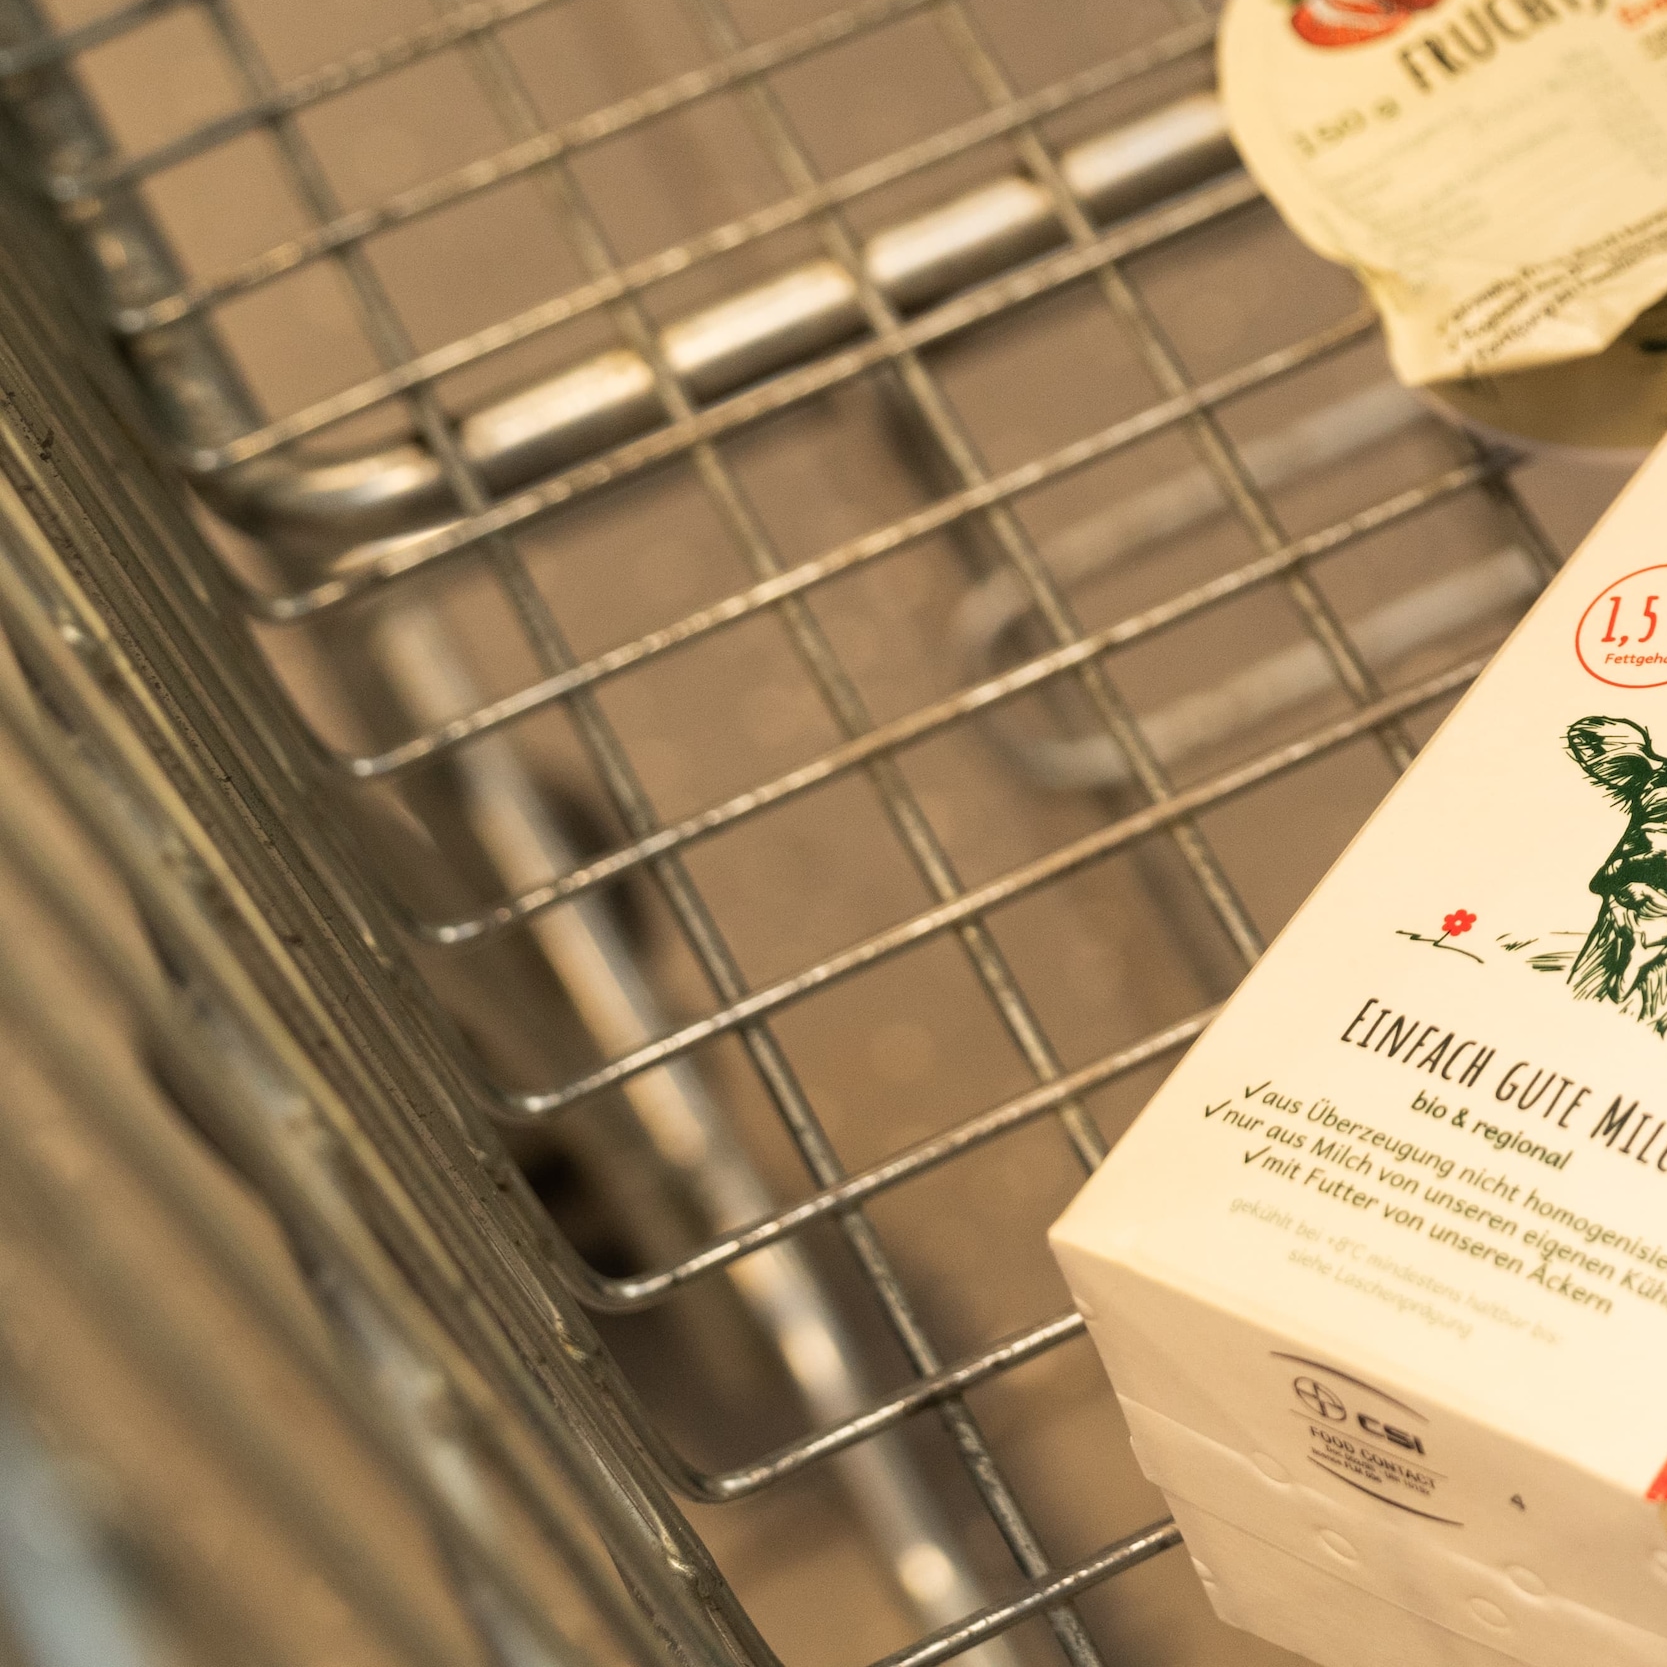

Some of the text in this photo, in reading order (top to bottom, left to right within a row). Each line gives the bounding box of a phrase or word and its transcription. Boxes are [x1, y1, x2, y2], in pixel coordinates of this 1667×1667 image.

[1597, 593, 1659, 648] 1,5
[1340, 997, 1496, 1088] EINFACH
[1494, 1061, 1592, 1129] GUTE
[1261, 1091, 1303, 1115] aus
[1306, 1102, 1456, 1180] Überzeugung
[1458, 1167, 1520, 1203] nicht
[1410, 1090, 1573, 1171] bio & regional
[1222, 1109, 1265, 1132] nur
[1265, 1125, 1307, 1149] aus
[1309, 1136, 1373, 1176] Milch
[1378, 1167, 1420, 1195] von
[1423, 1187, 1518, 1236] unseren
[1522, 1230, 1616, 1281] eigenen
[1261, 1155, 1613, 1314] mit Futter von unseren Äckern
